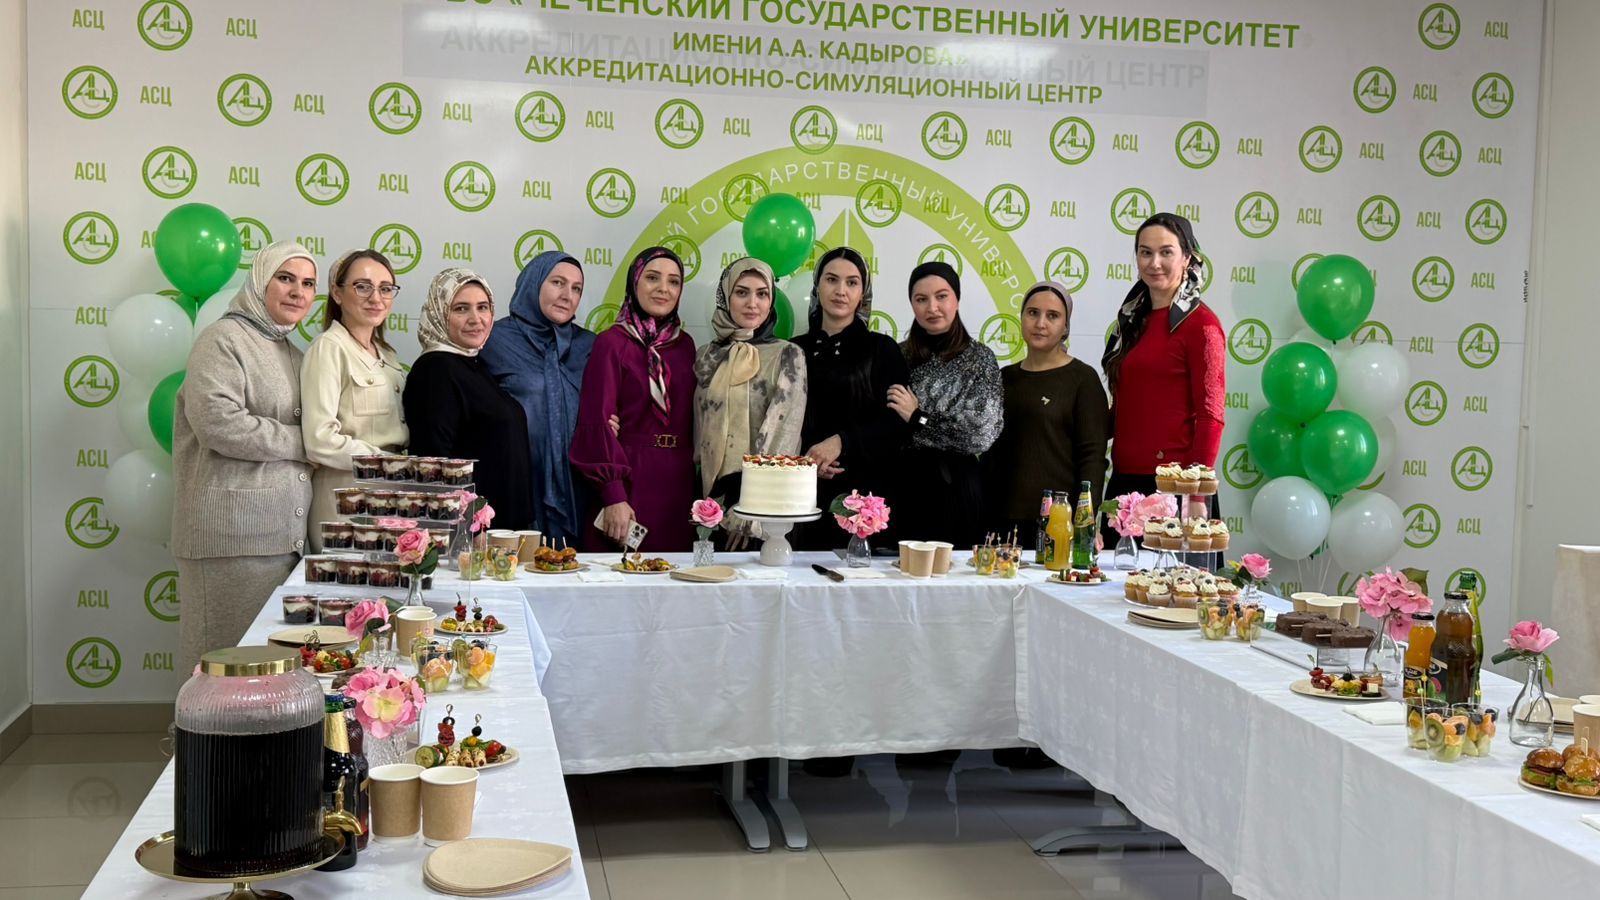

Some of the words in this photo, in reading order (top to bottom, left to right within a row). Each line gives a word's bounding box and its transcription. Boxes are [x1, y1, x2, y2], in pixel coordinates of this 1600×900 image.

[72, 9, 104, 31] АСЦ
[226, 17, 257, 39] АСЦ
[509, 0, 730, 20] ЕНСКИЙ
[743, 0, 1069, 39] ГОСУДАРСТВЕННЫЙ
[1080, 15, 1300, 48] УНИВЕРСИТЕТ
[1484, 21, 1508, 39] АСЦ
[673, 32, 762, 56] ИМЕНИ
[768, 37, 813, 59] А.А.
[525, 55, 1021, 101] АККРЕДИТАЦИОННО-СИМУЛЯЦИОННЫЙ
[1027, 83, 1103, 104] ЦЕНТР
[140, 85, 172, 107] АСЦ
[1413, 84, 1437, 103] АСЦ
[294, 94, 325, 115] АСЦ
[442, 102, 472, 124] АСЦ
[585, 111, 614, 131] АСЦ
[723, 117, 752, 137] АСЦ
[856, 124, 883, 144] АСЦ
[985, 129, 1013, 149] АСЦ
[1113, 134, 1139, 152] АСЦ
[1237, 138, 1263, 157] АСЦ
[1360, 143, 1384, 160] АСЦ
[1478, 147, 1502, 165] АСЦ
[74, 161, 107, 183] АСЦ
[228, 166, 260, 187] АСЦ
[377, 173, 409, 194] АСЦ
[522, 180, 552, 200] АСЦ
[660, 187, 688, 206] АСЦ
[924, 196, 950, 215] АСЦ
[1050, 200, 1076, 220] АСЦ
[1175, 205, 1200, 223] АСЦ
[1296, 208, 1323, 226] АСЦ
[1416, 211, 1441, 229] АСЦ
[141, 231, 156, 248] АС
[442, 242, 473, 262] АСЦ
[584, 248, 613, 268] АСЦ
[946, 204, 1024, 310] УНИВЕРС
[980, 260, 1007, 278] АСЦ
[1106, 263, 1132, 282] АСЦ
[1230, 266, 1256, 285] АСЦ
[1471, 272, 1495, 290] АСЦ
[75, 305, 107, 327] АСЦ
[1409, 336, 1434, 354] АСЦ
[1224, 391, 1249, 410] АСЦ
[1463, 396, 1488, 414] АСЦ
[76, 448, 109, 468] АСЦ
[1402, 460, 1427, 478] АСЦ
[1457, 518, 1481, 535] АСЦ
[77, 590, 109, 609] АСЦ
[143, 653, 174, 671] АСЦ
